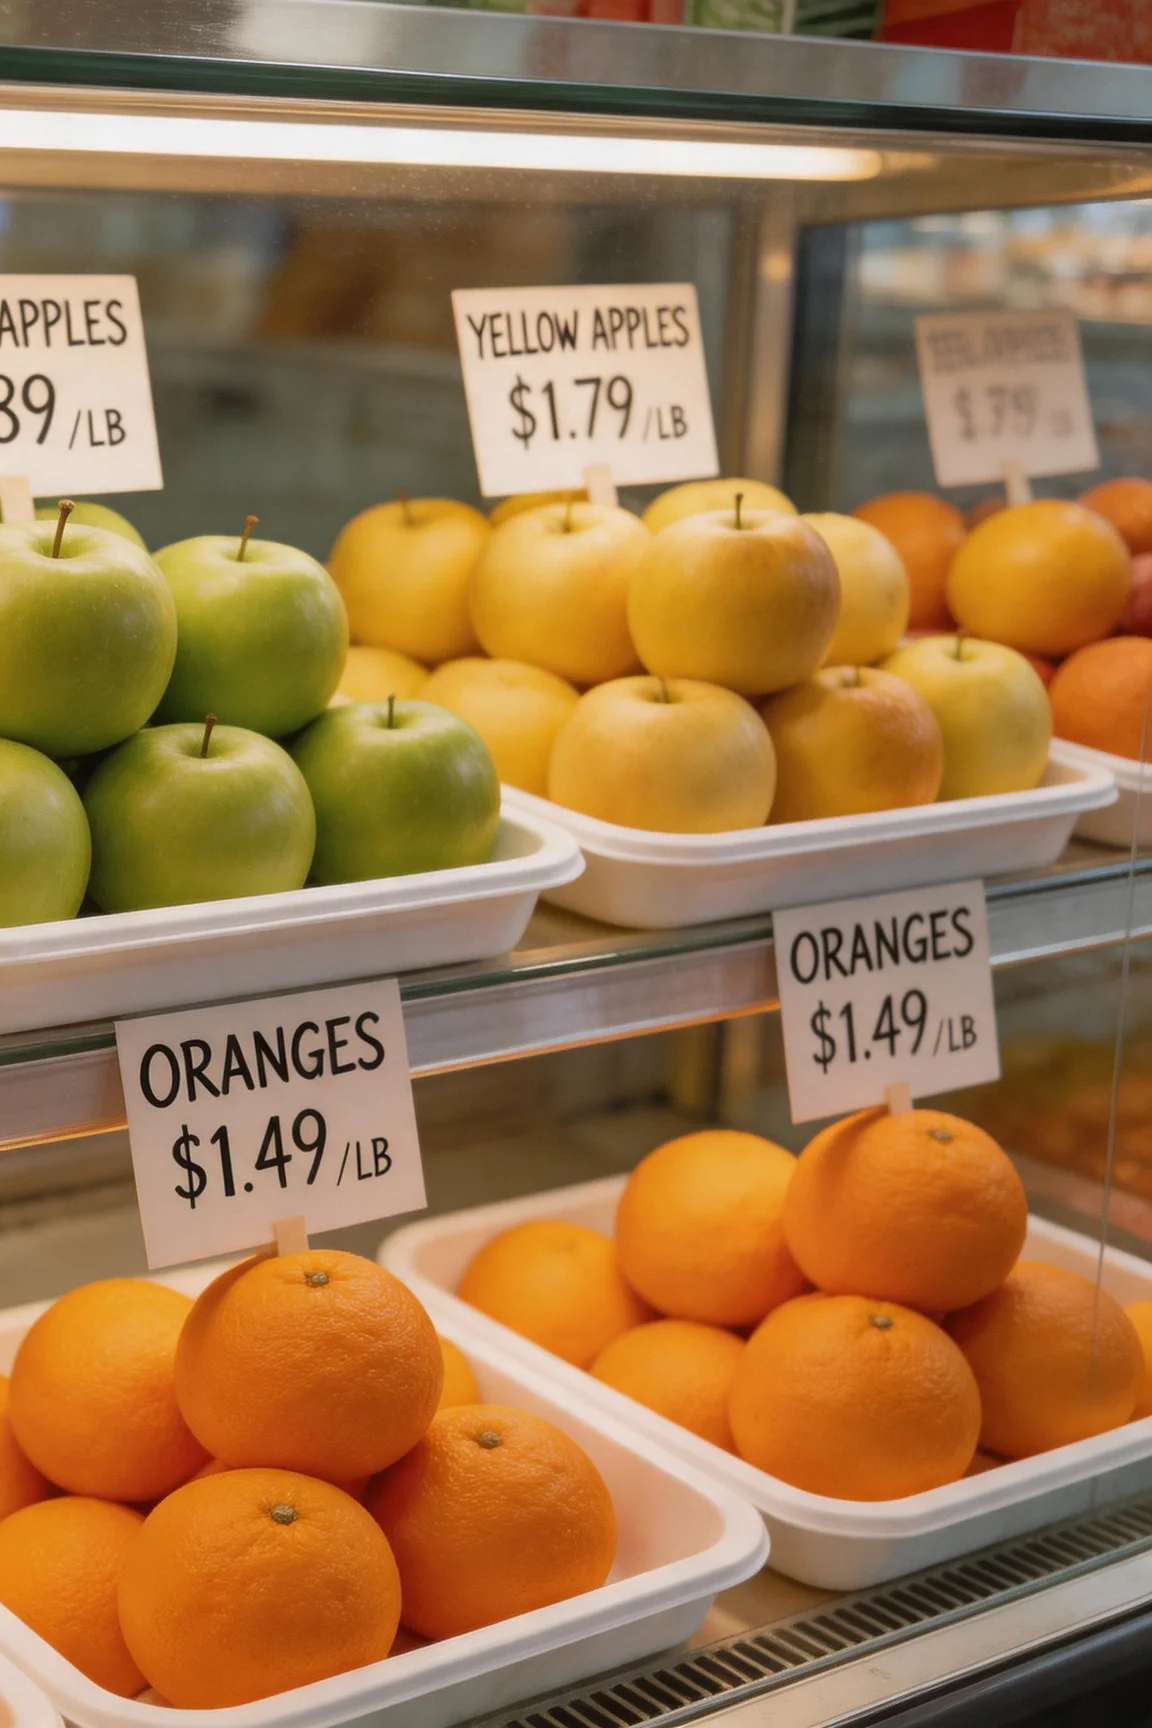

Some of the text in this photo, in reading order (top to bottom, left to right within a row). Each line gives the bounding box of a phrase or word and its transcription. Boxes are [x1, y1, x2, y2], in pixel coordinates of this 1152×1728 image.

[467, 305, 690, 360] YELLOW APPLES
[68, 409, 127, 450] /LB
[508, 375, 688, 451] $1.79 /LB
[790, 906, 976, 985] ORANGES
[139, 1010, 386, 1109] ORANGES
[809, 988, 978, 1074] $1.49 /LB
[171, 1107, 393, 1210] $1.49 /LB
